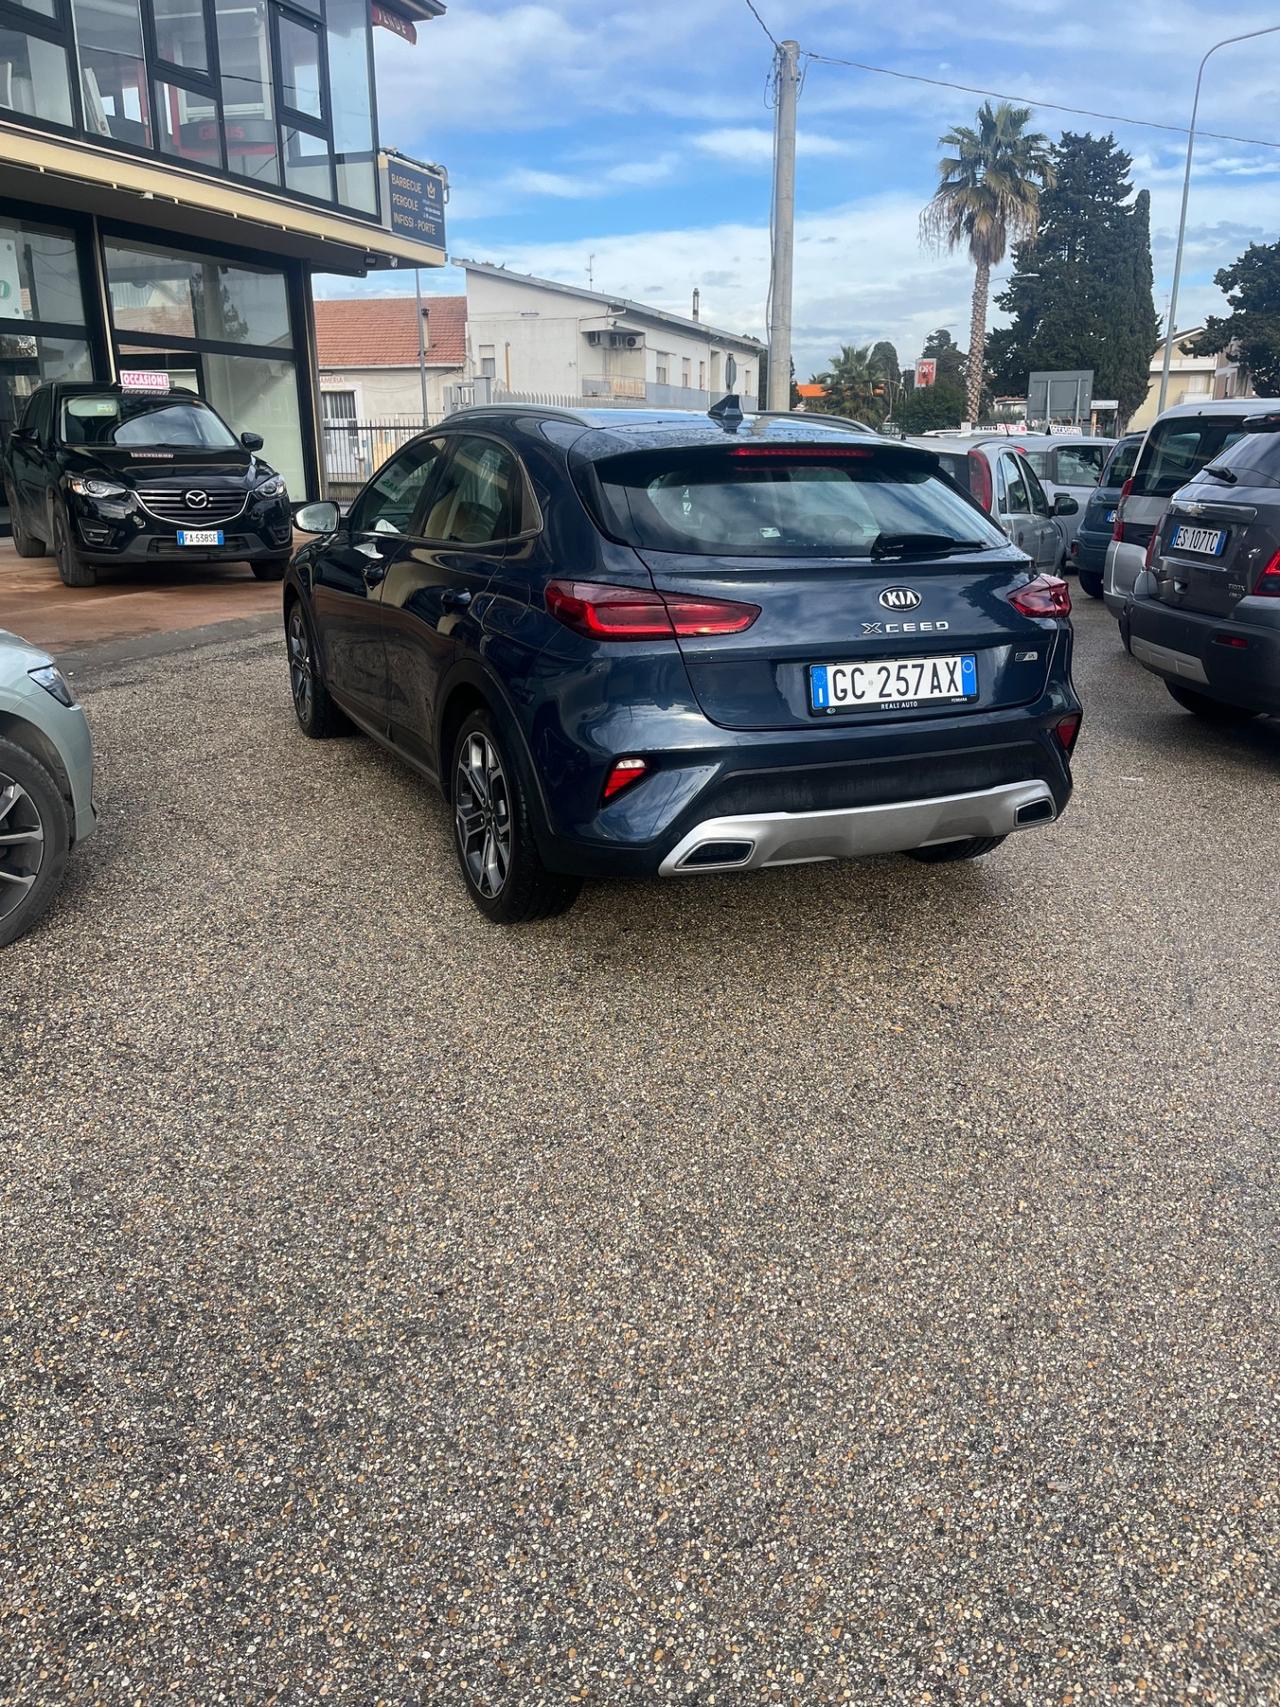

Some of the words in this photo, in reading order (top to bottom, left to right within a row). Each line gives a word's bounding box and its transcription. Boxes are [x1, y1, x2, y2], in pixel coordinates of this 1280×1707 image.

[391, 173, 422, 194] BARBECUE
[393, 193, 418, 211] PERGOLE
[394, 212, 414, 229] INFISSI
[417, 220, 436, 235] PORTE
[123, 373, 168, 386] OCCASIONE
[1175, 528, 1189, 547] ES
[1189, 529, 1219, 552] 107TC
[886, 591, 917, 606] KIA
[861, 621, 949, 634] XCEED
[832, 667, 866, 702] GC
[877, 661, 959, 699] 257AX
[881, 702, 900, 710] REALI
